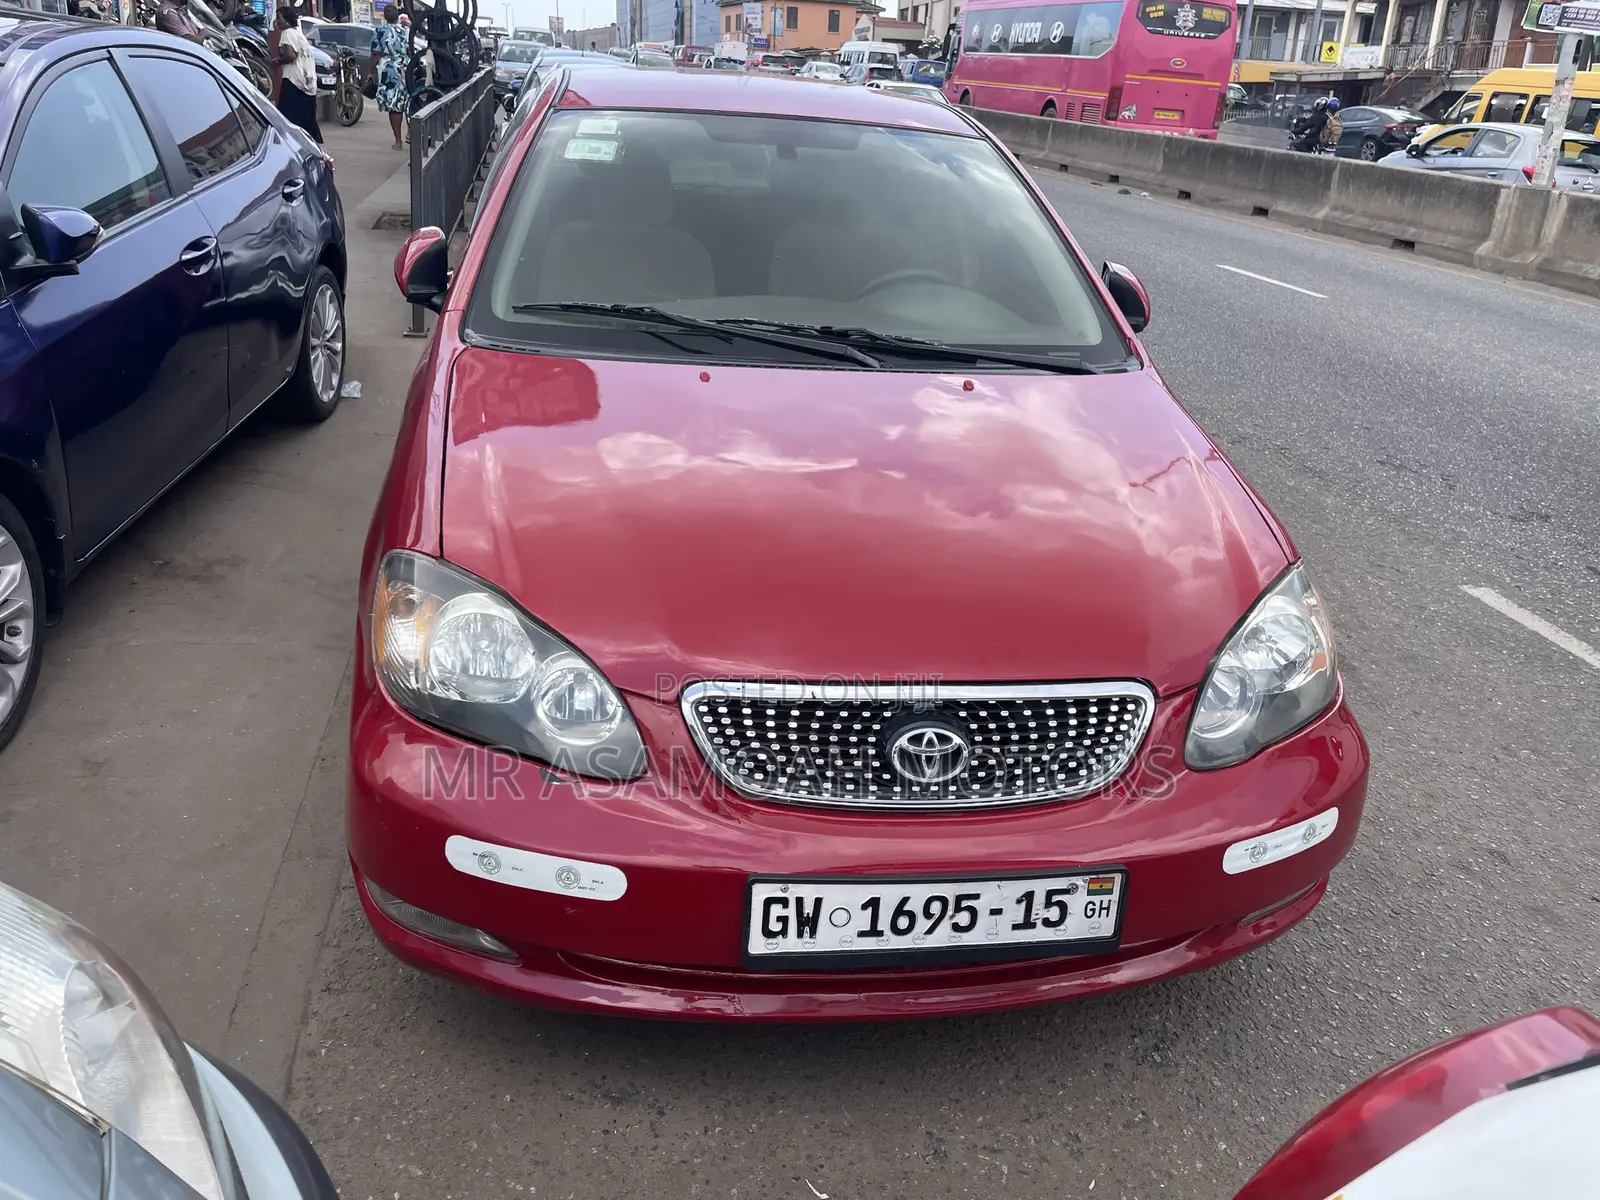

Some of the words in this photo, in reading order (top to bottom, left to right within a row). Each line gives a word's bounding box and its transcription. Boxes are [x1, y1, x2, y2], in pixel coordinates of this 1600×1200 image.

[761, 896, 823, 940] GW
[856, 888, 1071, 938] 1695-15
[1083, 900, 1111, 920] GH
